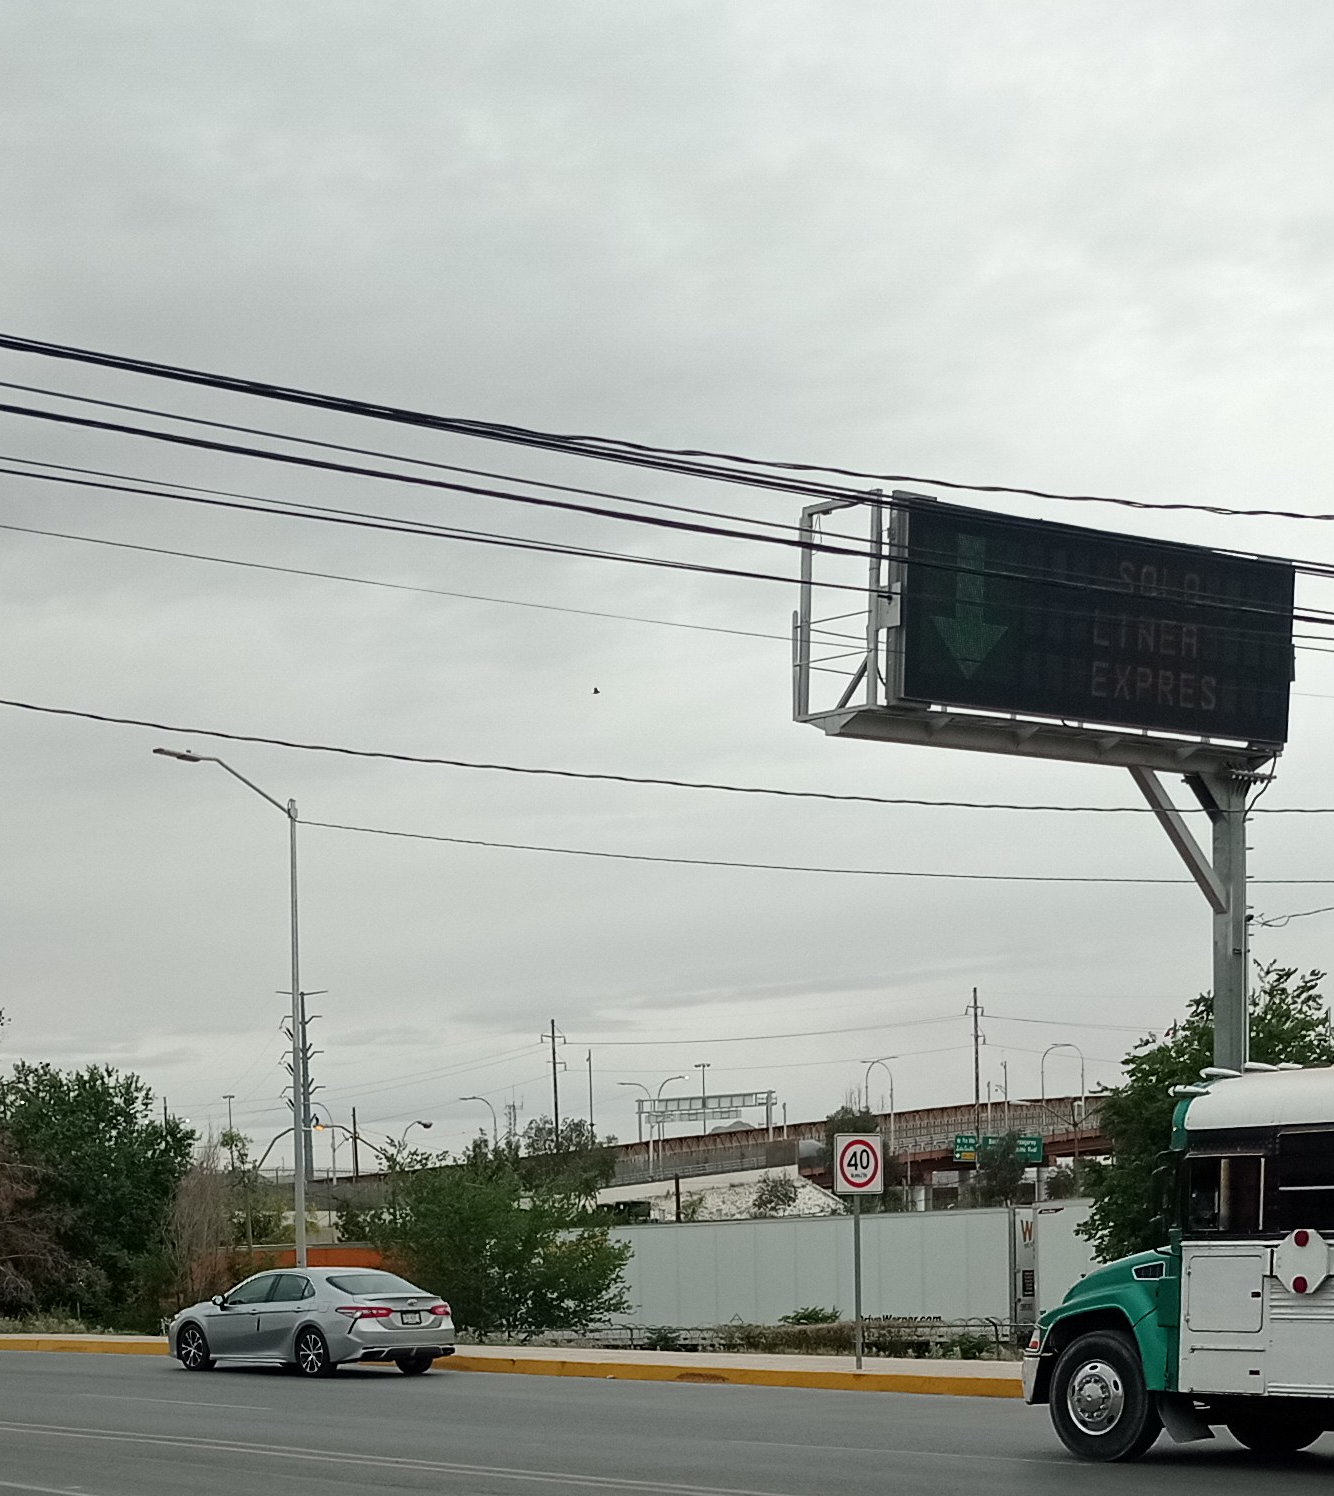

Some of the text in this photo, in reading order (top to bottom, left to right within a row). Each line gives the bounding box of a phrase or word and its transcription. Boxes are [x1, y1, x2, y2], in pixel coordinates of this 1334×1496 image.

[1119, 561, 1201, 609] SOLO
[1092, 608, 1198, 659] LINEA
[1091, 661, 1217, 711] EXPRES
[847, 1149, 870, 1171] 40
